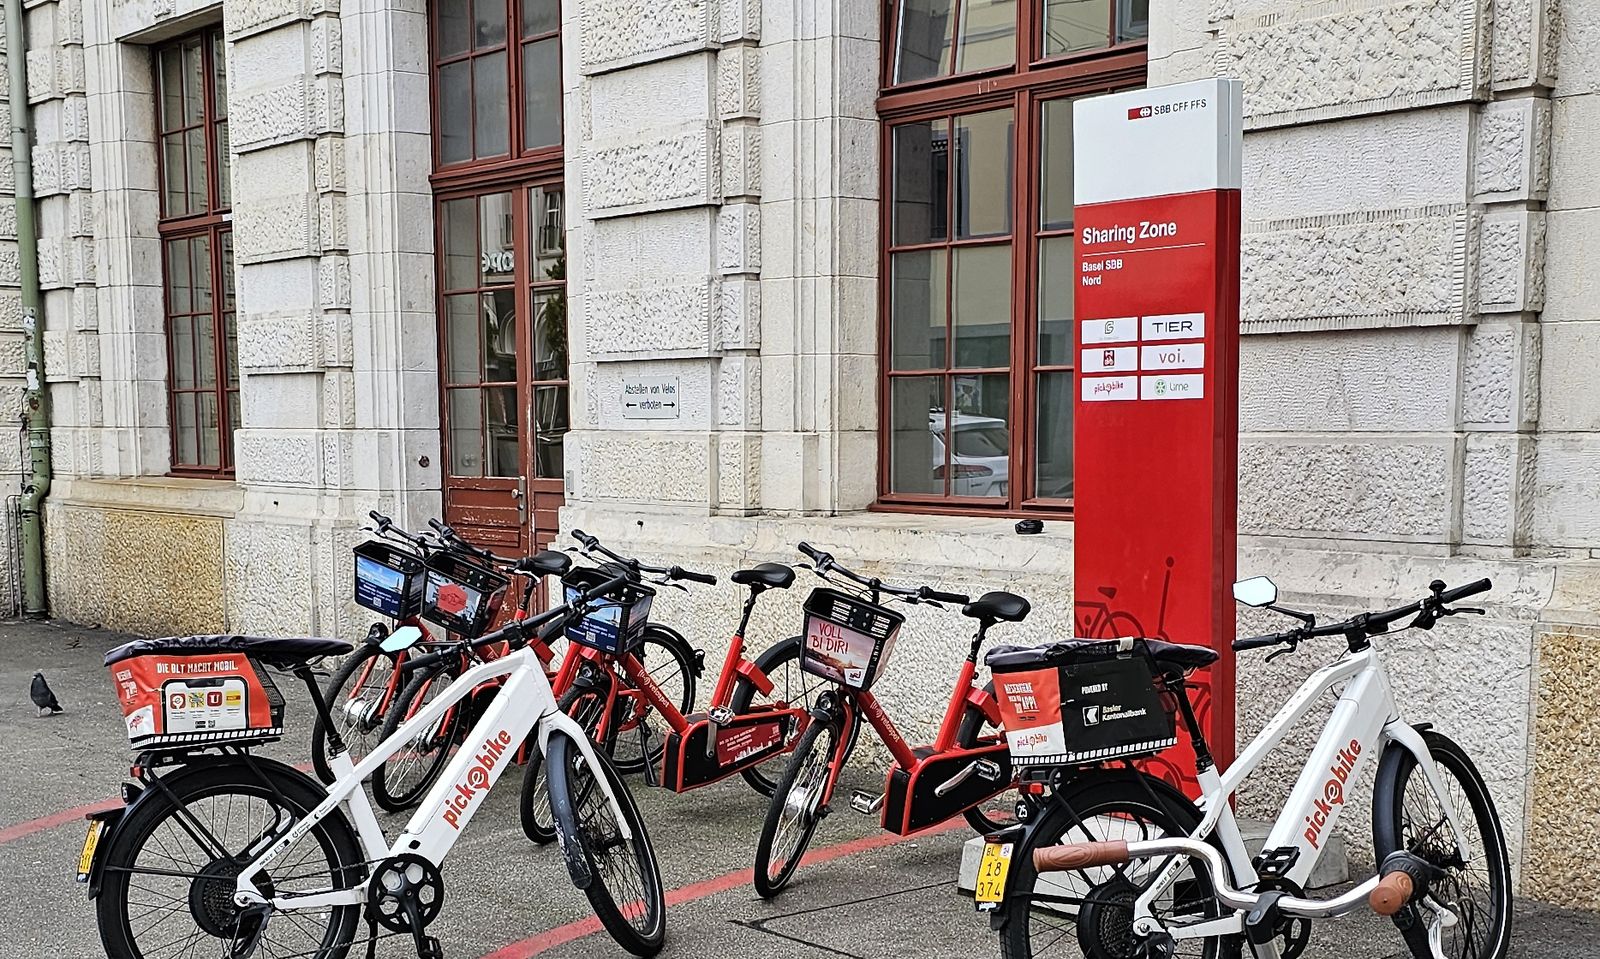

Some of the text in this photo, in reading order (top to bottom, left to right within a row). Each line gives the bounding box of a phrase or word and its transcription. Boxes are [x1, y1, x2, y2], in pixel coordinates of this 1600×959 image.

[1154, 98, 1206, 115] SBB CFF FFS
[1082, 221, 1176, 244] Sharing Zone
[1082, 259, 1122, 272] Basel SBB
[1082, 275, 1102, 286] Nord
[1152, 320, 1193, 333] TIER
[1159, 348, 1185, 364] voi.
[625, 383, 676, 394] Abstellen von Velos
[639, 399, 662, 410] verboten
[819, 622, 844, 640] VOLL
[811, 635, 823, 648] BI
[156, 663, 170, 674] DIE
[187, 662, 212, 673] MACHT
[1102, 704, 1122, 714] Basler
[1102, 707, 1146, 722] Kantonalbank
[986, 862, 1002, 876] 18
[978, 882, 1001, 898] 374
